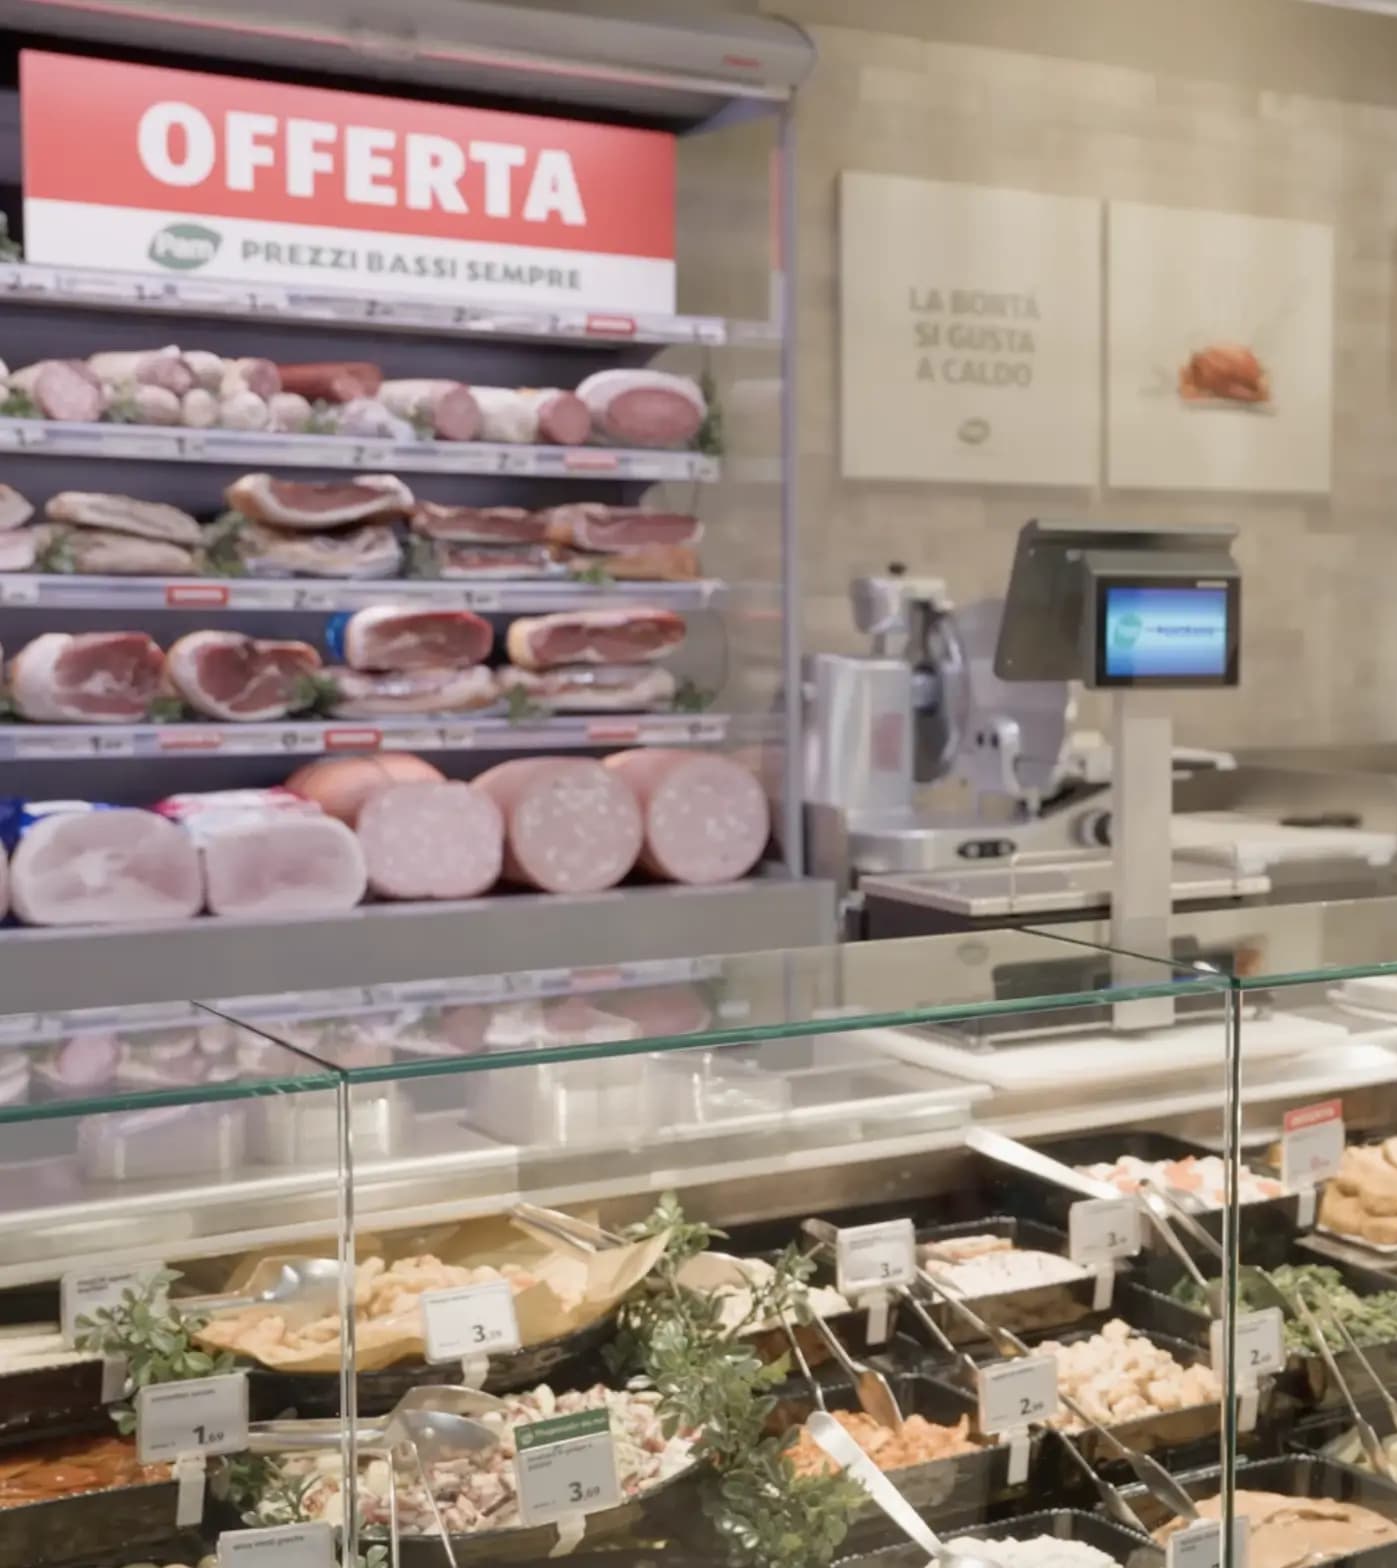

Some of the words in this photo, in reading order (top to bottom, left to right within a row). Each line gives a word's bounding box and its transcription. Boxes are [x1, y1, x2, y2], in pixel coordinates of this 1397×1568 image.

[136, 100, 588, 227] OFFERTA
[241, 239, 358, 271] PREZZI
[366, 249, 458, 280] BASSI
[466, 260, 582, 291] SEMPRE
[908, 286, 945, 313] LA
[913, 321, 940, 349] SI
[946, 323, 1036, 353] GUSTA
[915, 355, 936, 383] A
[941, 358, 1034, 389] CALDO
